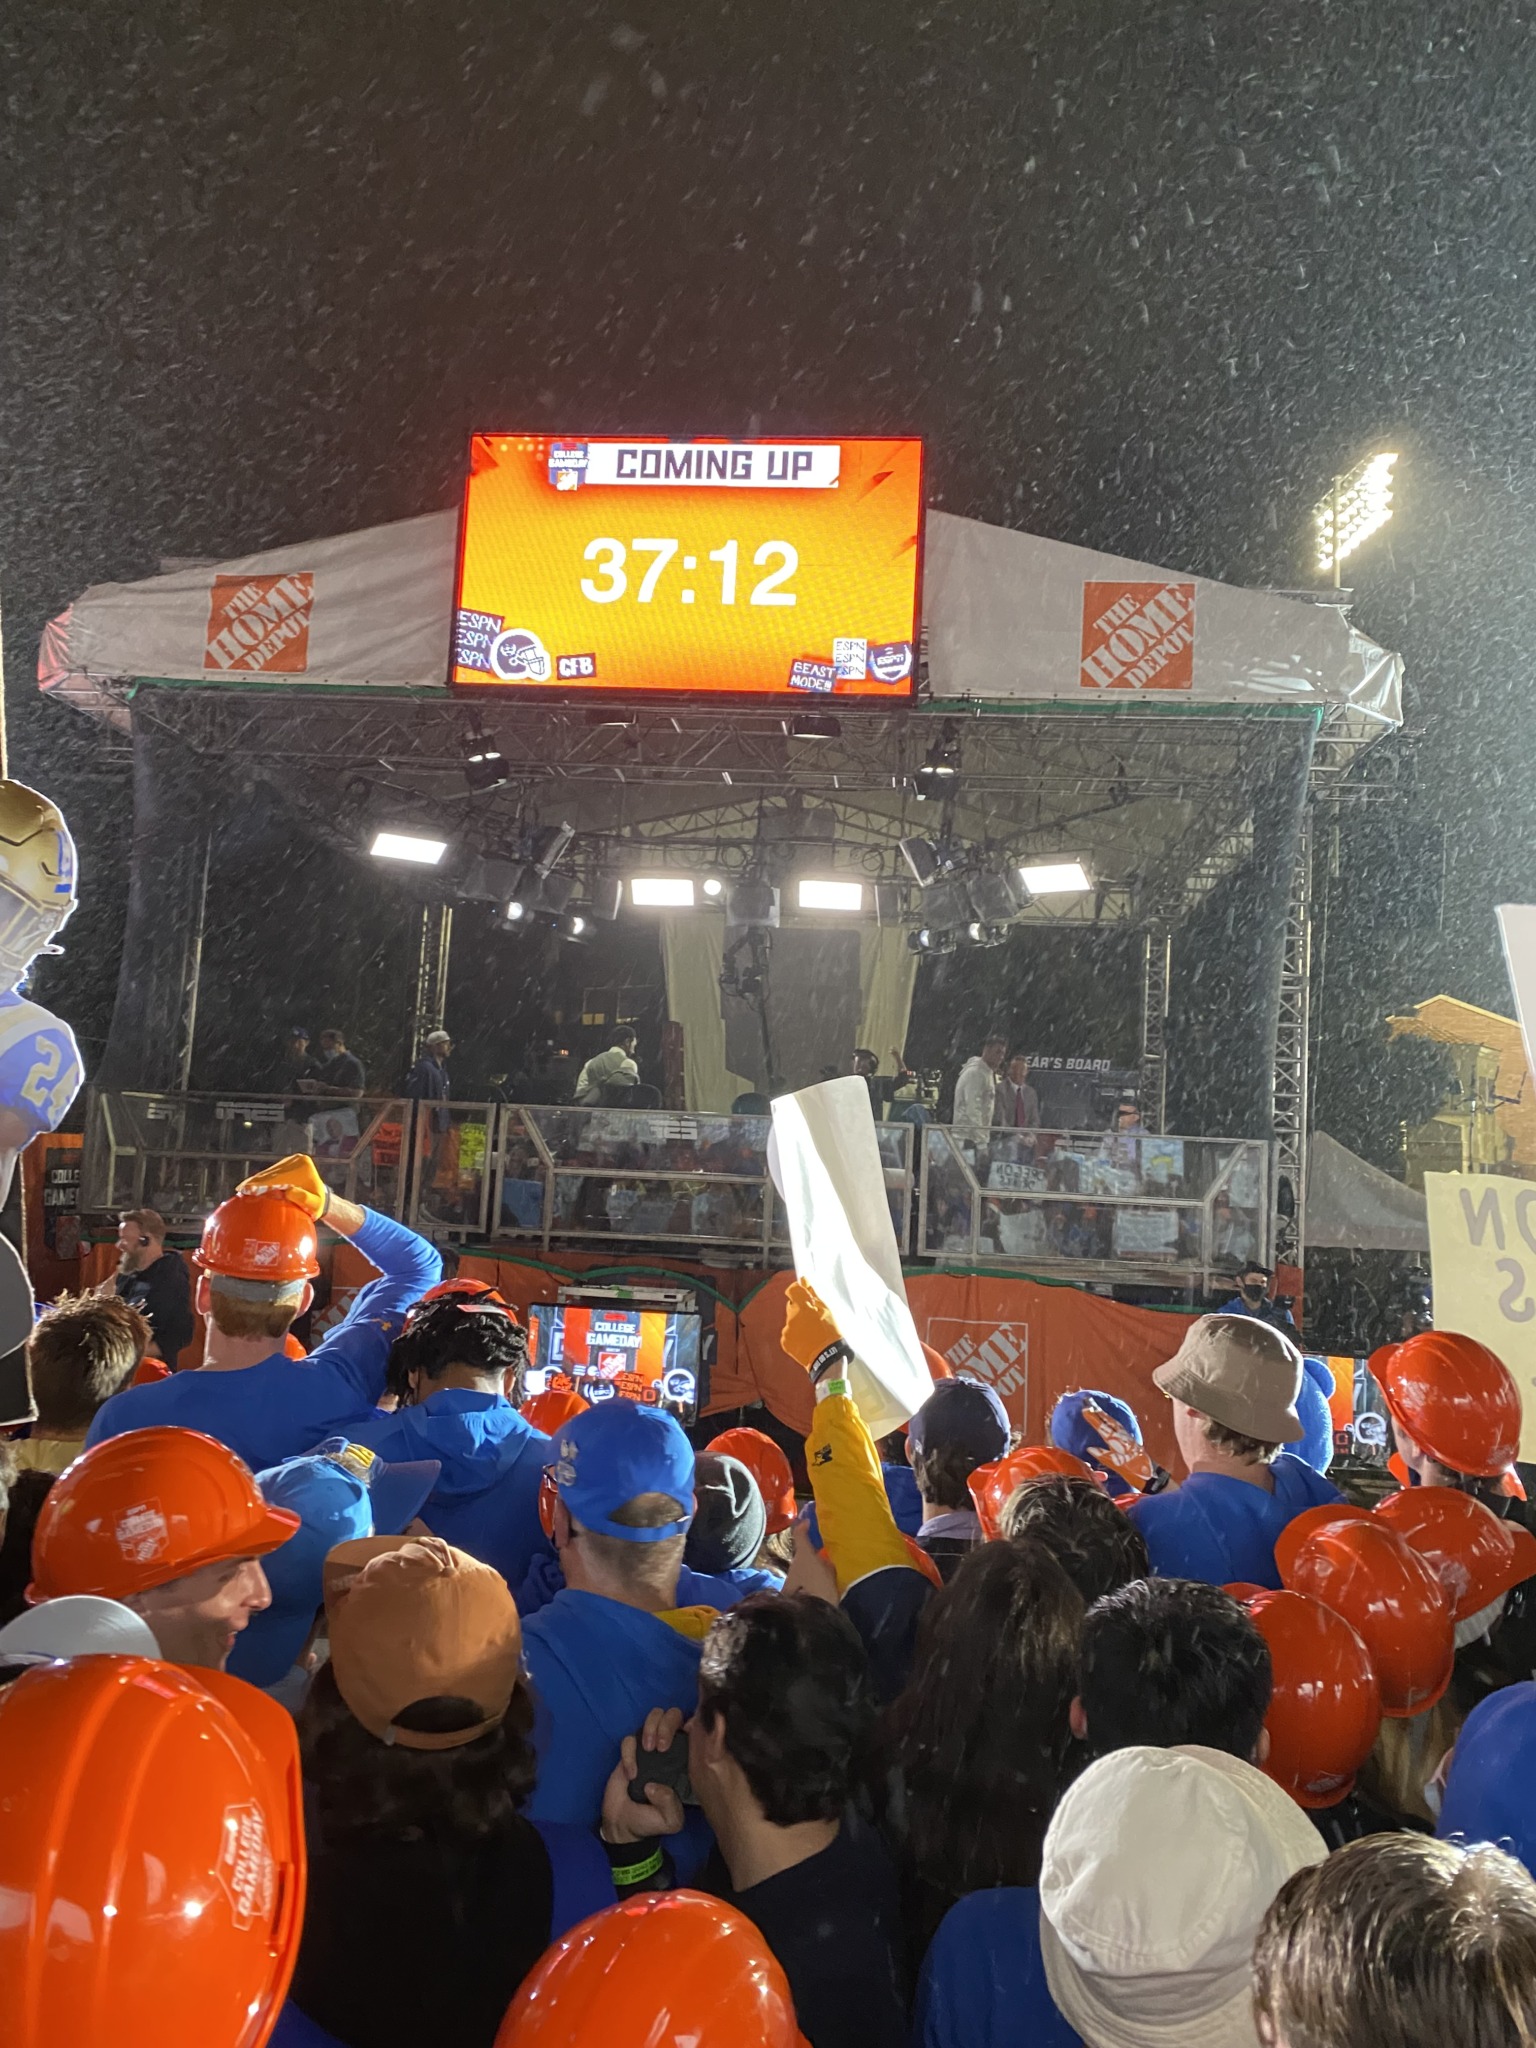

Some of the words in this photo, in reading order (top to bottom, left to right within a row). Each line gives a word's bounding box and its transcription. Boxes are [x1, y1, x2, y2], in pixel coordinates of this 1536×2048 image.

[616, 448, 753, 481] COMING
[766, 450, 813, 481] UP
[580, 536, 798, 606] 37:12
[220, 582, 264, 620] THE
[1092, 593, 1141, 635] THE
[206, 573, 315, 670] HOME
[459, 610, 502, 634] ESPN
[1081, 582, 1195, 688] HOME
[243, 608, 311, 671] DEPOT
[836, 641, 865, 651] ESPN
[1124, 622, 1194, 689] DEPOT
[559, 656, 594, 677] CFB
[793, 661, 836, 679] BEAST
[1024, 1056, 1062, 1069] EAR'S
[1065, 1058, 1111, 1072] BOARD
[51, 1169, 80, 1184] COLLE
[44, 1187, 79, 1206] GAME
[586, 1331, 642, 1348] GAMEDAY
[594, 1321, 636, 1334] COLLEGE
[231, 1814, 252, 1892] COLLEGE
[238, 1805, 263, 1917] GAMEDAY
